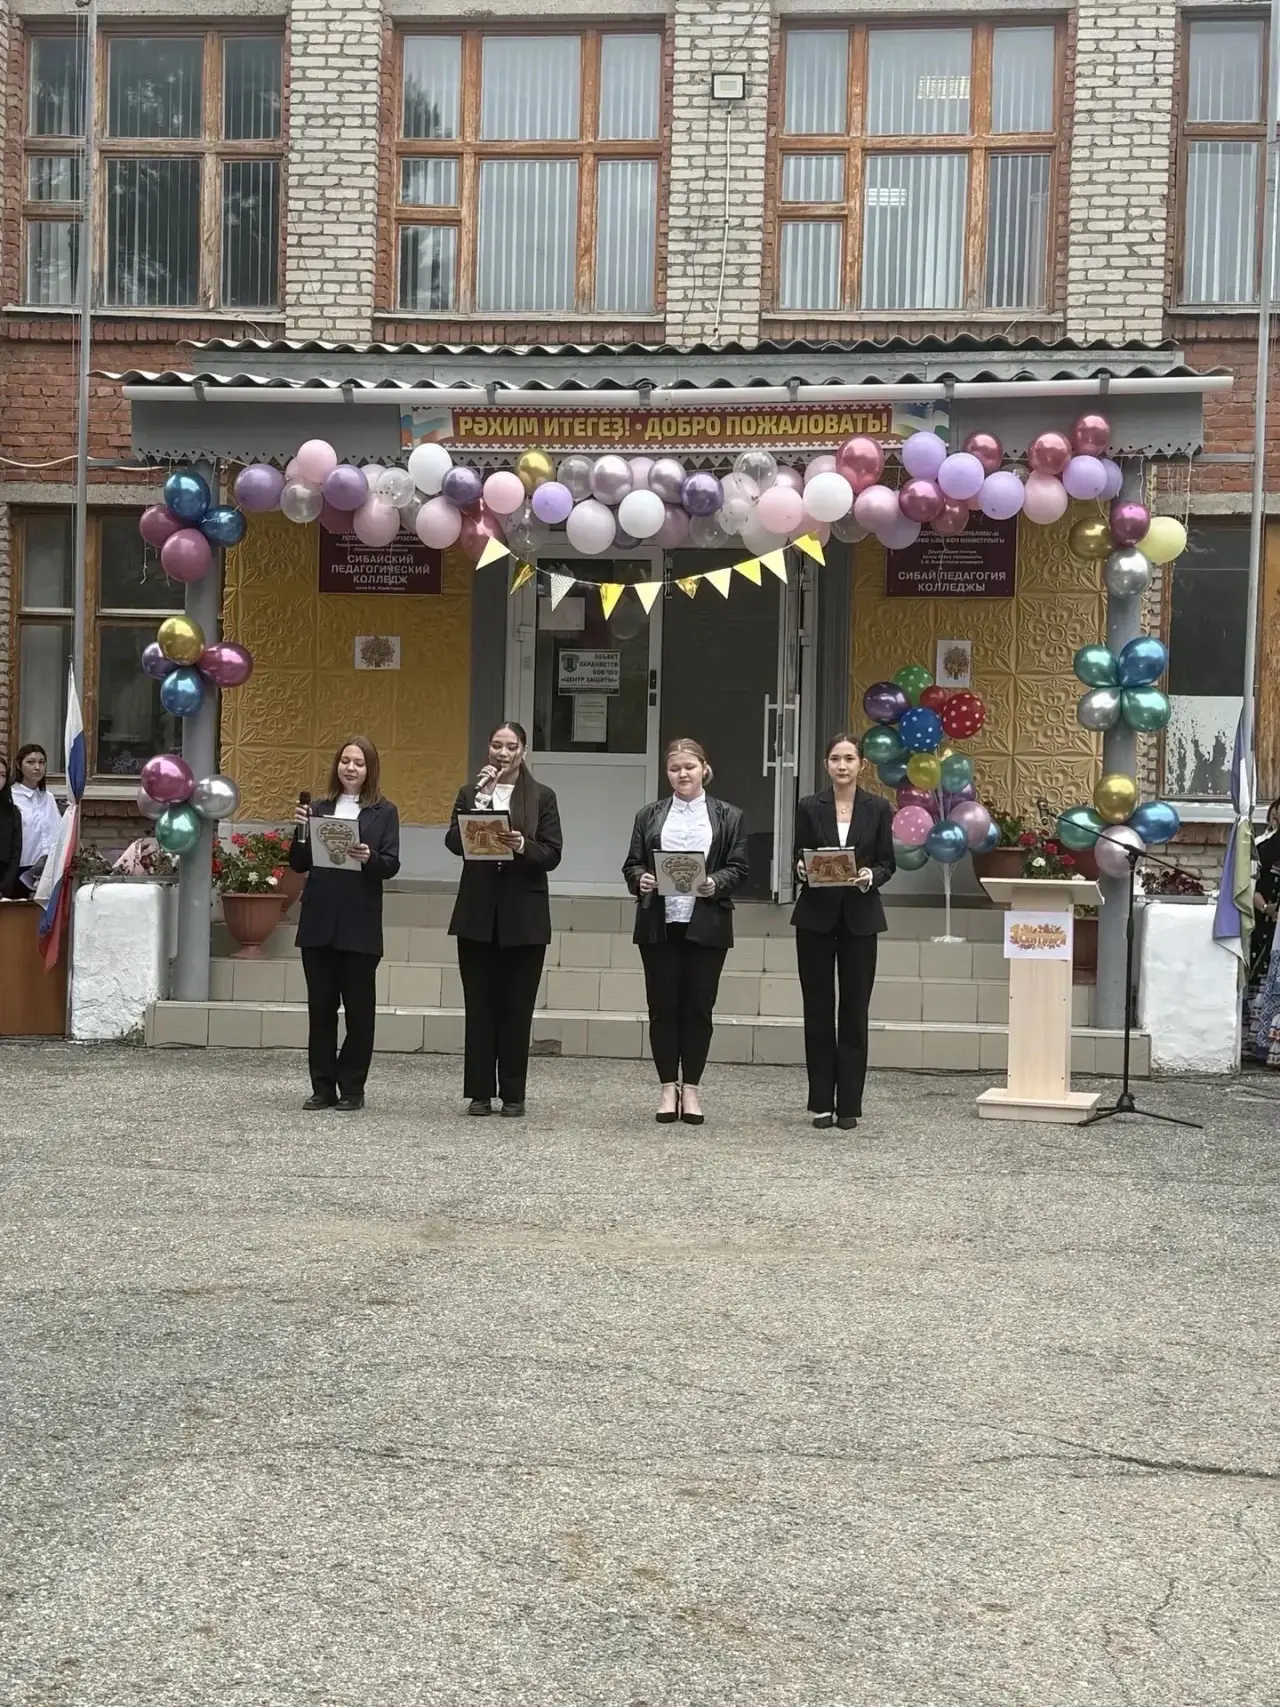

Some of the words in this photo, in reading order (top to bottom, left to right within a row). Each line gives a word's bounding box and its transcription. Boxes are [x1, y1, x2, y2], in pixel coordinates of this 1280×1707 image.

[459, 416, 539, 437] РӘХИМ
[644, 416, 721, 440] ДОБРО
[726, 413, 888, 437] ПОЖАЛОВАТЬ!
[347, 554, 414, 565] СИБАЙСКИЙ
[331, 564, 430, 574] ПЕДАГОГИЧЕСКИЙ
[353, 575, 408, 585] КОЛЛЕДЖ
[898, 569, 936, 580] СИБАЙ
[940, 571, 1006, 582] ПЕДАГОГИЯ
[918, 582, 985, 593] КОЛЛЕДЖЫ
